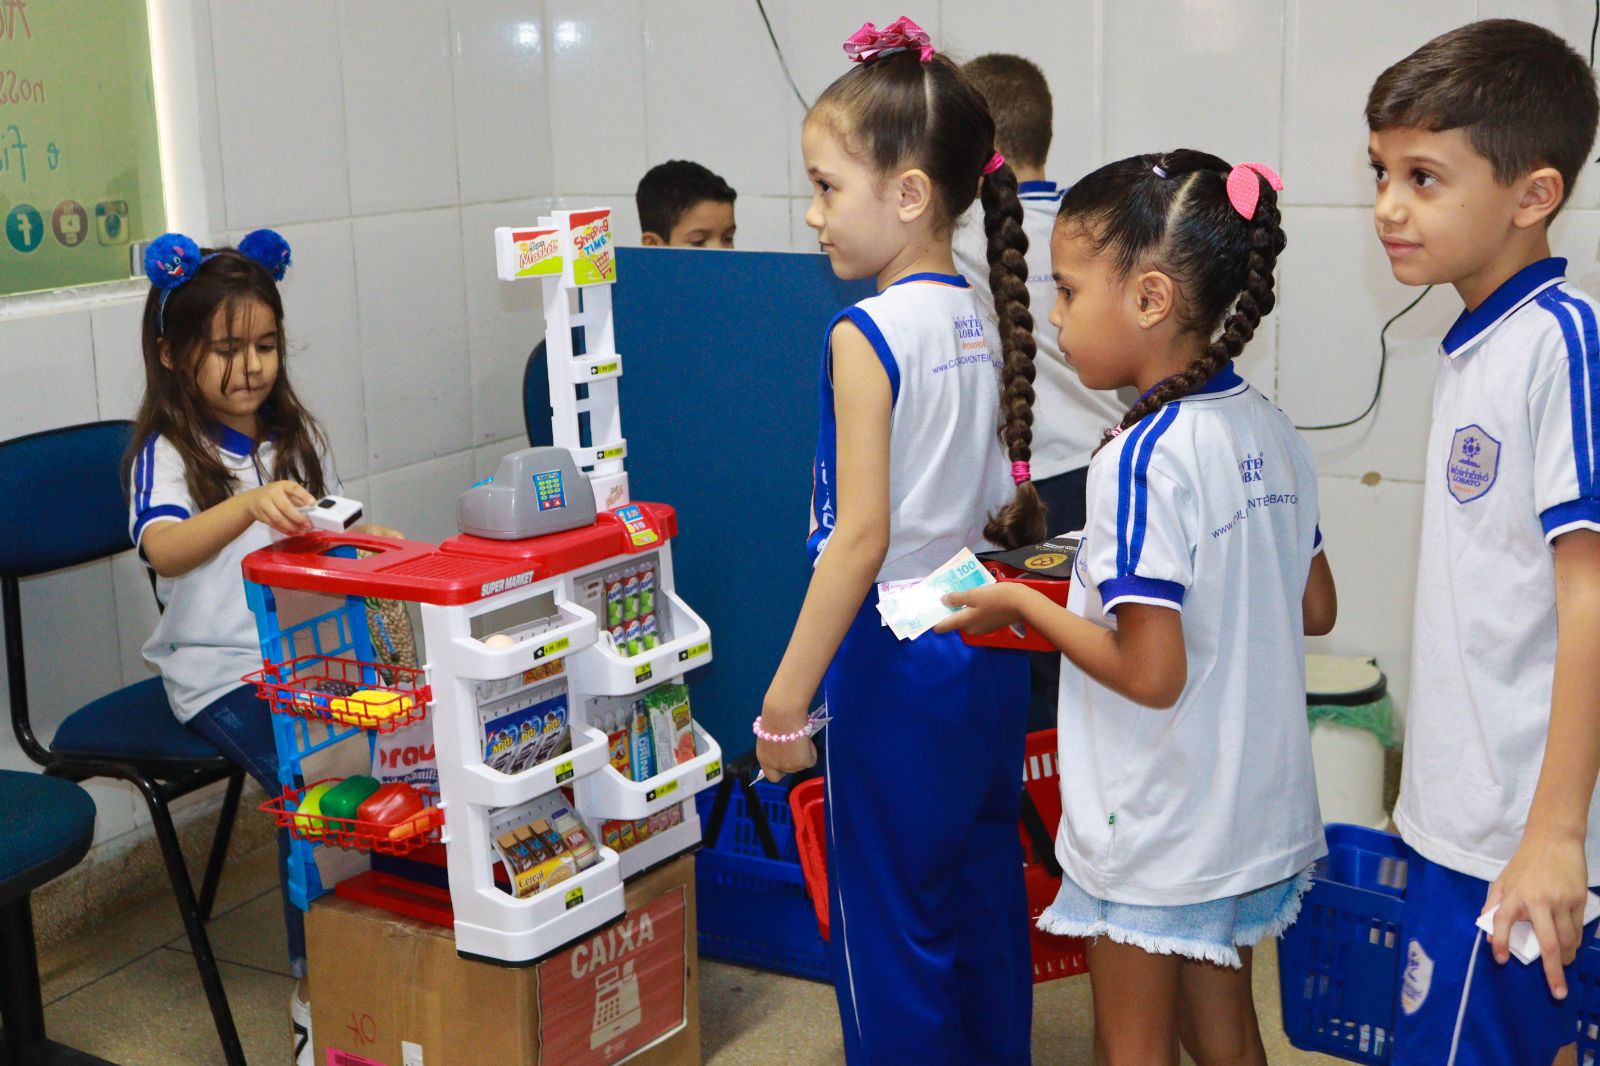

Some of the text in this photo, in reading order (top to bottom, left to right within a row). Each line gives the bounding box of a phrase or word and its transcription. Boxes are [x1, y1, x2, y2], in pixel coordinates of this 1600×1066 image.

[584, 235, 607, 255] TIME
[956, 560, 976, 577] 100
[481, 570, 534, 597] SUPER MARKET
[638, 735, 651, 780] DRINK
[518, 869, 544, 889] Cereal
[570, 912, 654, 980] CAIXA
